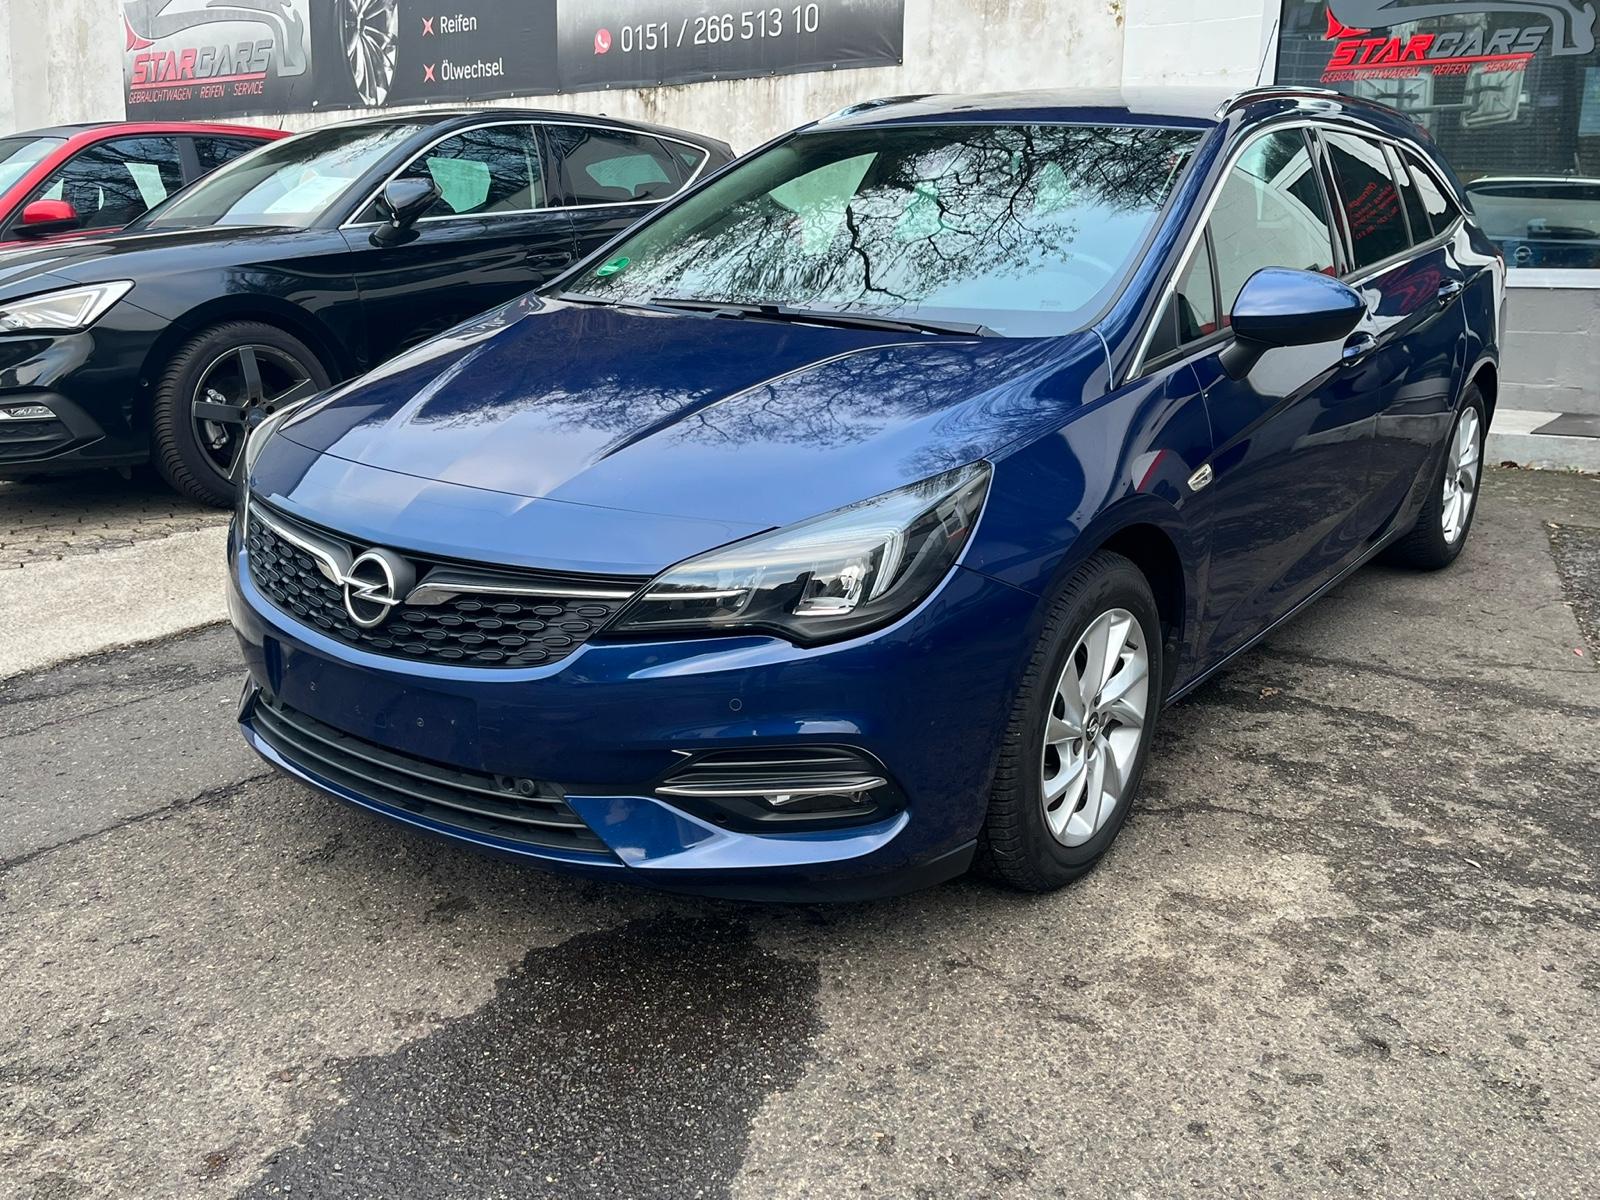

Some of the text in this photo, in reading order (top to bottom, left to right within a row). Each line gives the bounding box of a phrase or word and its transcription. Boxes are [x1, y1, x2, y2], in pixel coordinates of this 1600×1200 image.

[440, 14, 477, 33] Reifen
[621, 3, 819, 52] 0151 / 266 513 10
[1328, 26, 1550, 66] STARCARS
[132, 39, 273, 84] STARCARS
[441, 57, 504, 80] Ölwechsel
[1432, 63, 1470, 75] REIFEN
[129, 81, 264, 104] GEBRAUCHTWAGEN REIFEN SERVICE
